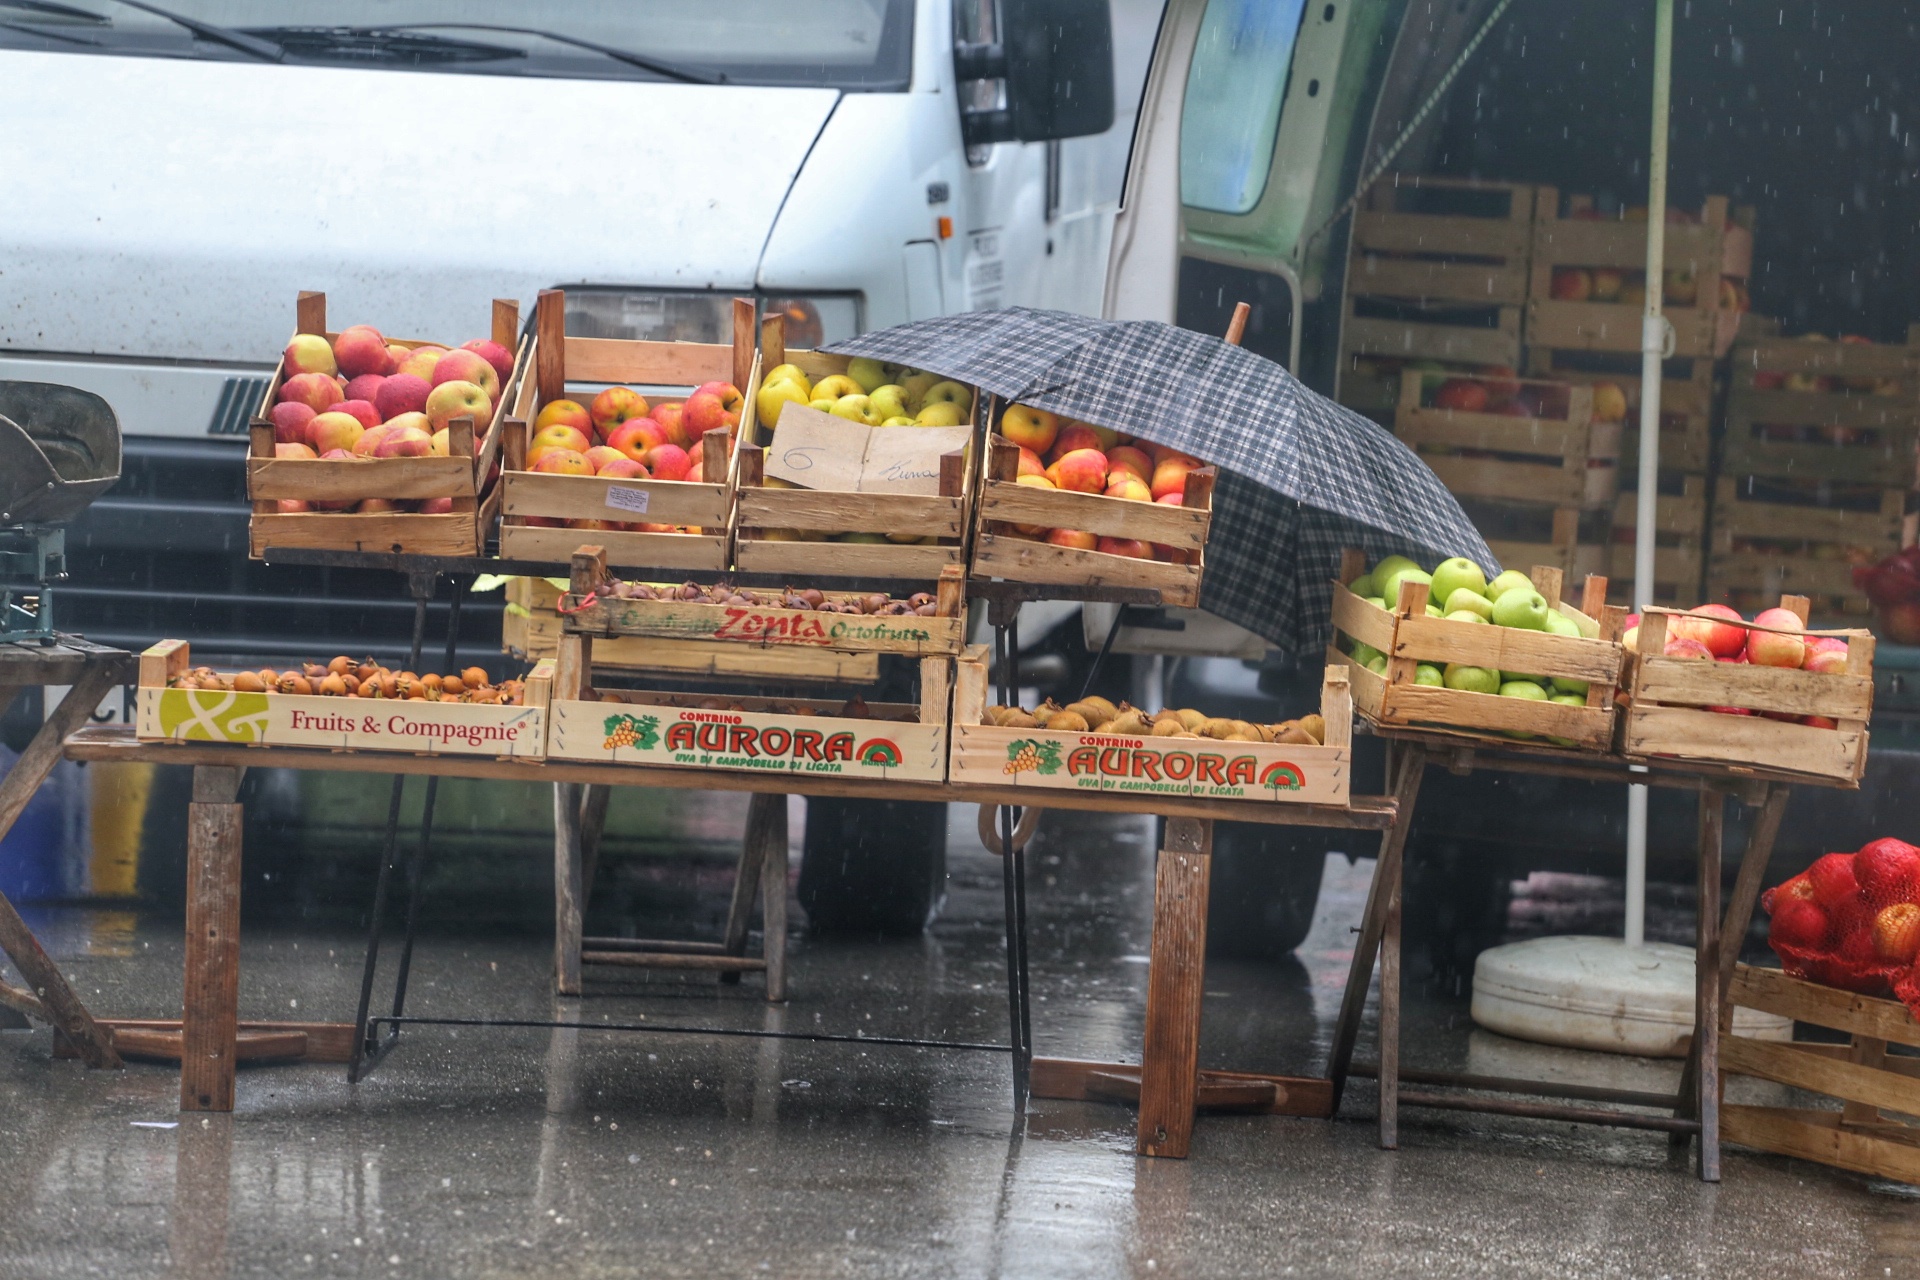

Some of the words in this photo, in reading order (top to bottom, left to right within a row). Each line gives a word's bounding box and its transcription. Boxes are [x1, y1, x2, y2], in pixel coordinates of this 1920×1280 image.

[714, 606, 826, 639] Zonta
[830, 621, 930, 642] Ortofrutta
[290, 709, 356, 733] Fruits
[362, 715, 382, 735] &
[679, 711, 743, 726] CONTRINO
[664, 721, 856, 763] AURORA
[1079, 736, 1144, 749] CONTRINO
[674, 753, 697, 764] UVA
[700, 755, 713, 765] DI
[716, 756, 786, 770] CAMPOBELLO
[789, 760, 803, 771] DI
[805, 762, 843, 774] LICATA
[1067, 746, 1258, 787] AURORA
[1077, 778, 1100, 789] UVA
[1103, 780, 1117, 789] DI
[1119, 781, 1190, 794] CAMPOBELLO
[1192, 785, 1206, 795] DI
[1208, 786, 1245, 797] LICATA
